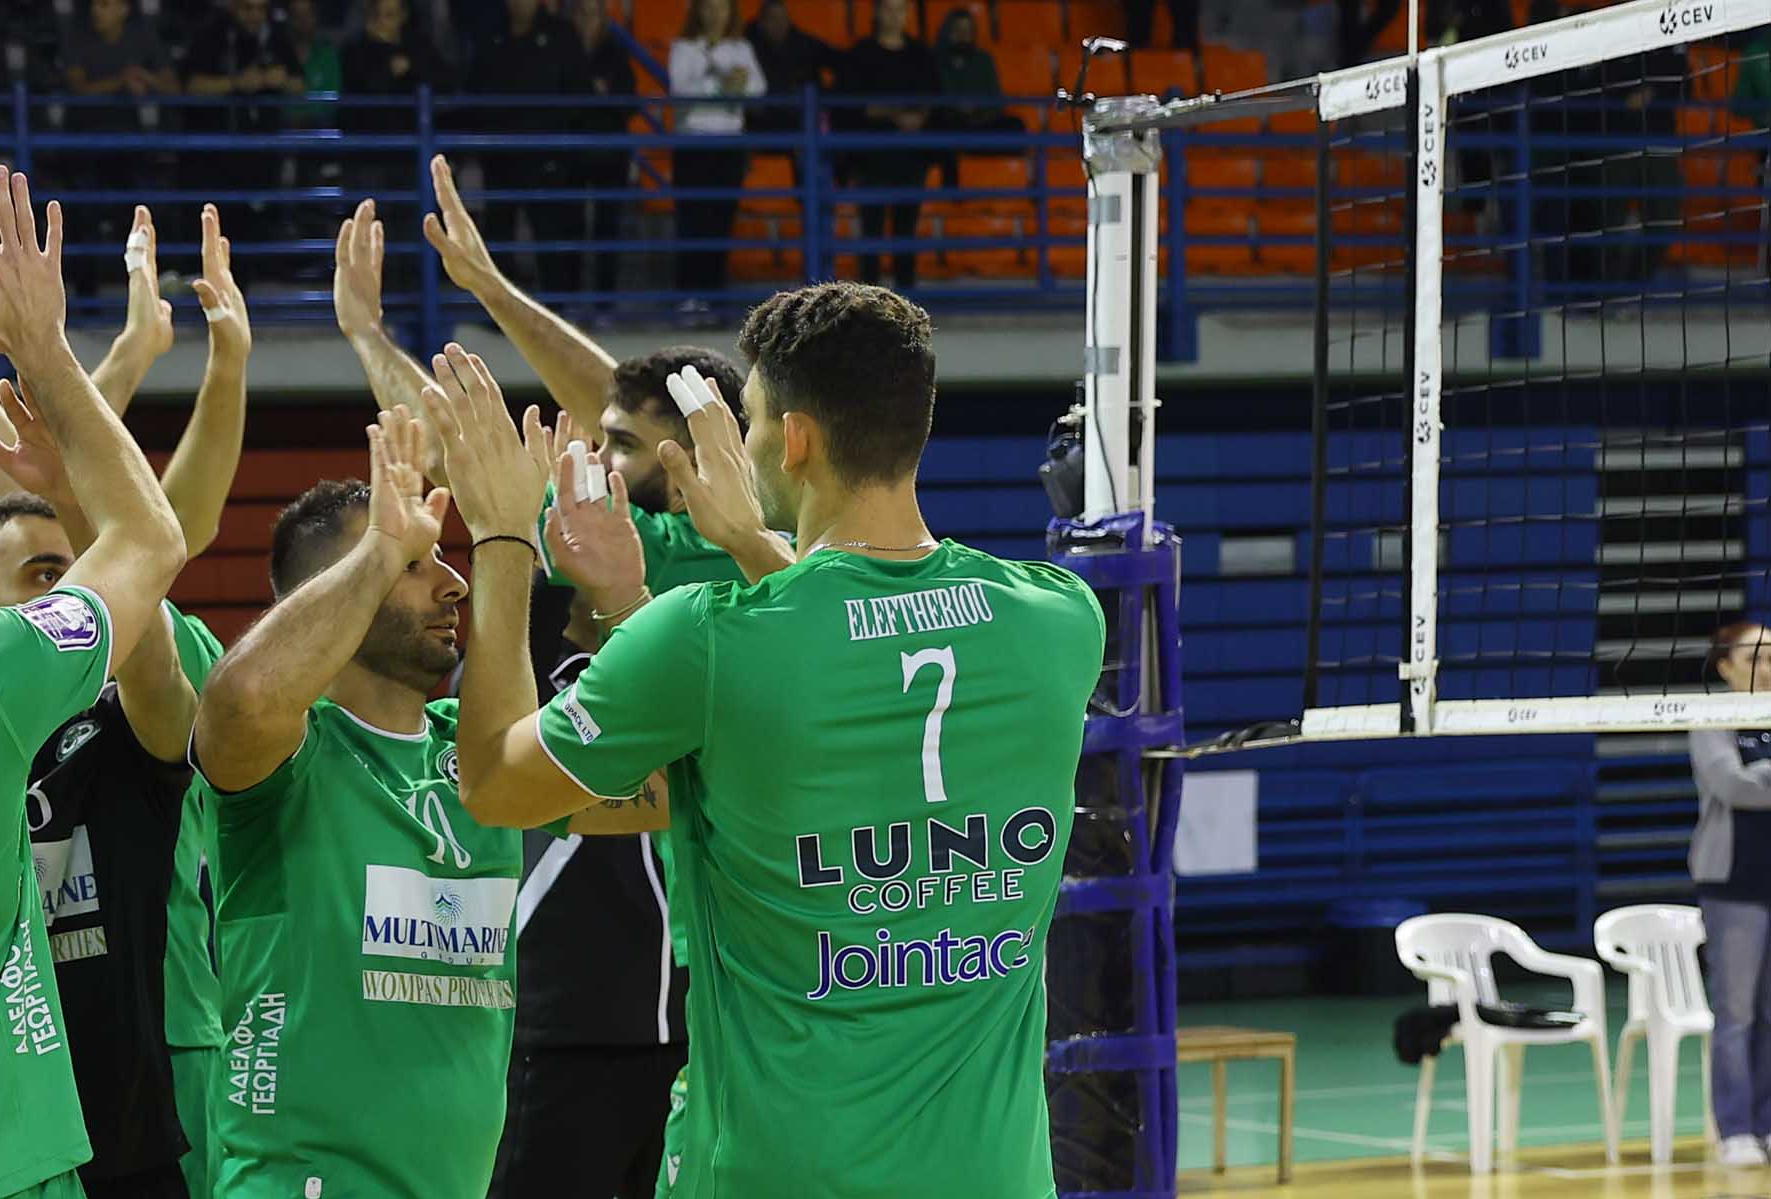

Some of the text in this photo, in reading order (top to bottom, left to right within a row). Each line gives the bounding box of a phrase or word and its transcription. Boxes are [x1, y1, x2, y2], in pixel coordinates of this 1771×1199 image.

[1681, 5, 1713, 26] CEV
[1522, 44, 1548, 63] CEV
[1424, 104, 1434, 153] CEV
[1419, 372, 1431, 414] CEV
[844, 583, 993, 640] ELEFTHERIOU
[1415, 616, 1425, 662] CEV
[581, 726, 594, 742] LTD
[900, 645, 957, 803] 7
[405, 790, 471, 869] 10
[796, 807, 1057, 888] LUNO
[848, 868, 1024, 914] COFFEE
[53, 927, 108, 961] RTIES
[0, 944, 29, 1054] ΑΔΕΛΦΟ
[364, 972, 442, 1004] WOMPAS
[228, 1002, 255, 1107] ΑΔΕΛΦΟ
[252, 992, 286, 1114] ΓΕΩΡΓΙΑΔΗ
